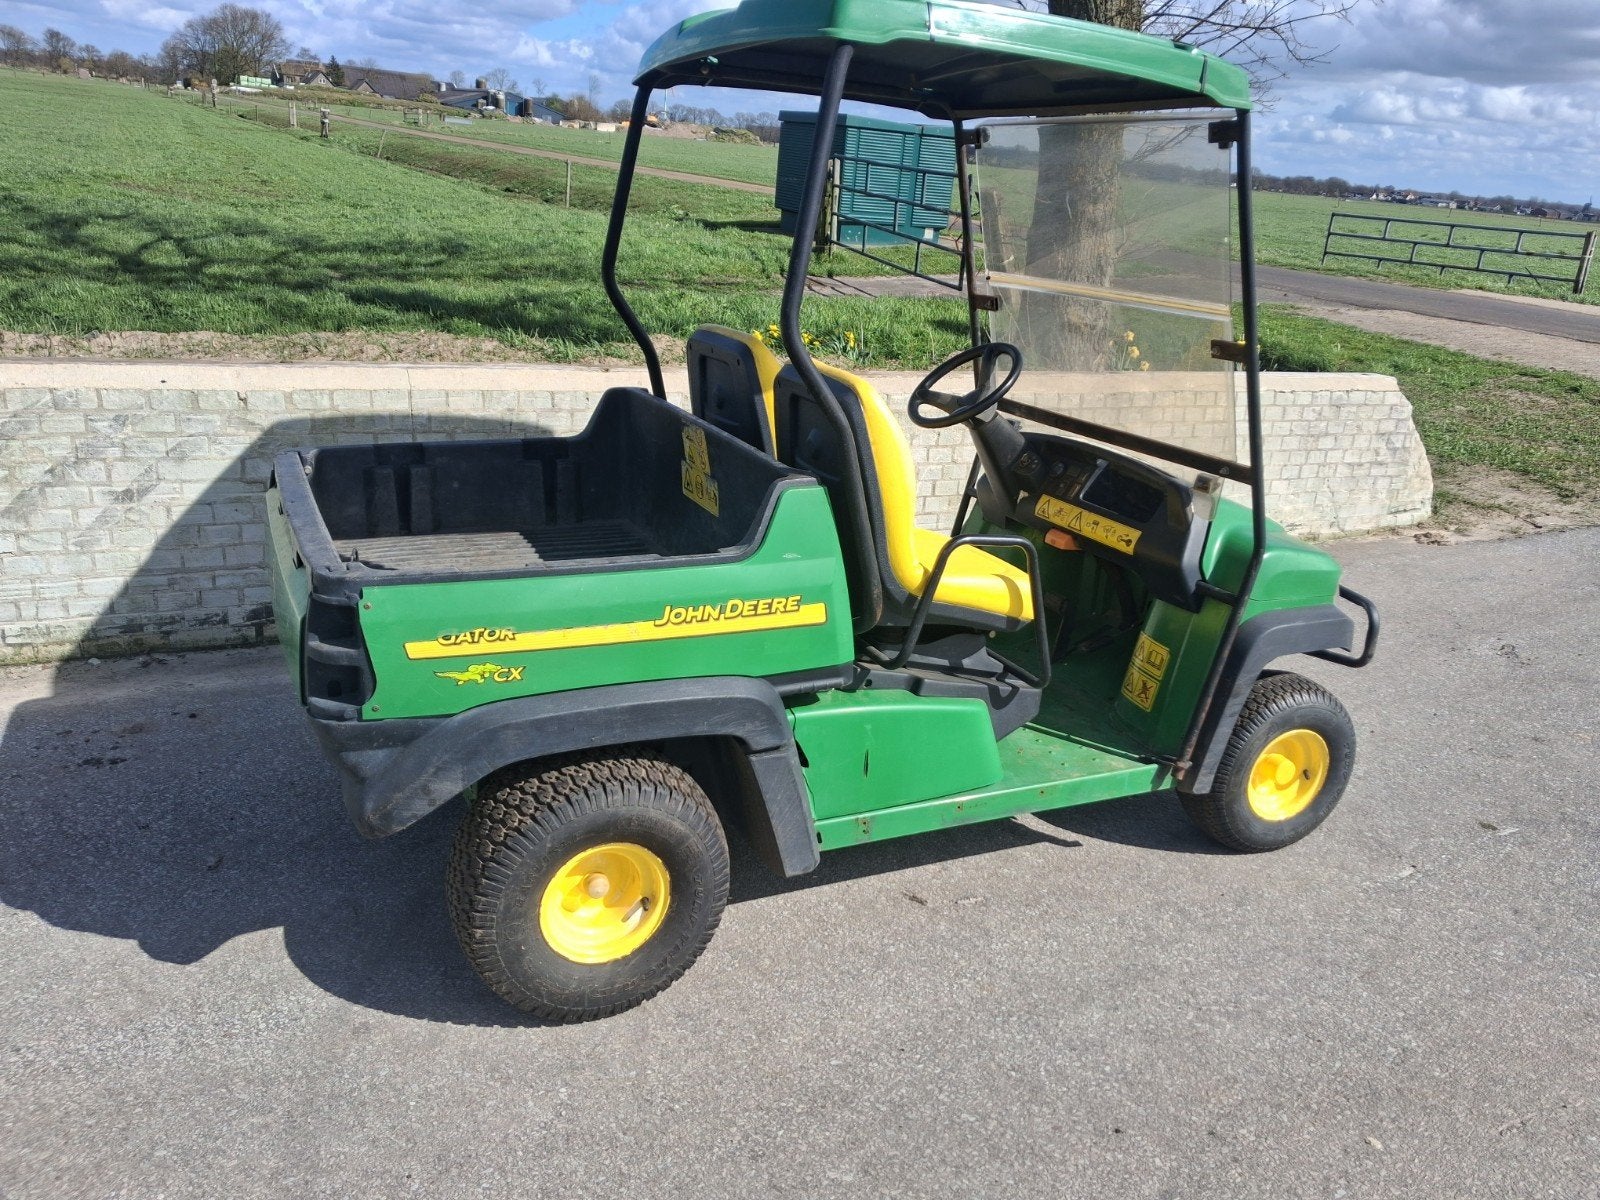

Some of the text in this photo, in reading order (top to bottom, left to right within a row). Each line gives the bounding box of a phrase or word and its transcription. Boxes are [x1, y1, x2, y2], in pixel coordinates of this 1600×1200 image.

[654, 595, 802, 627] JOHN DEERE
[493, 665, 526, 683] CX
